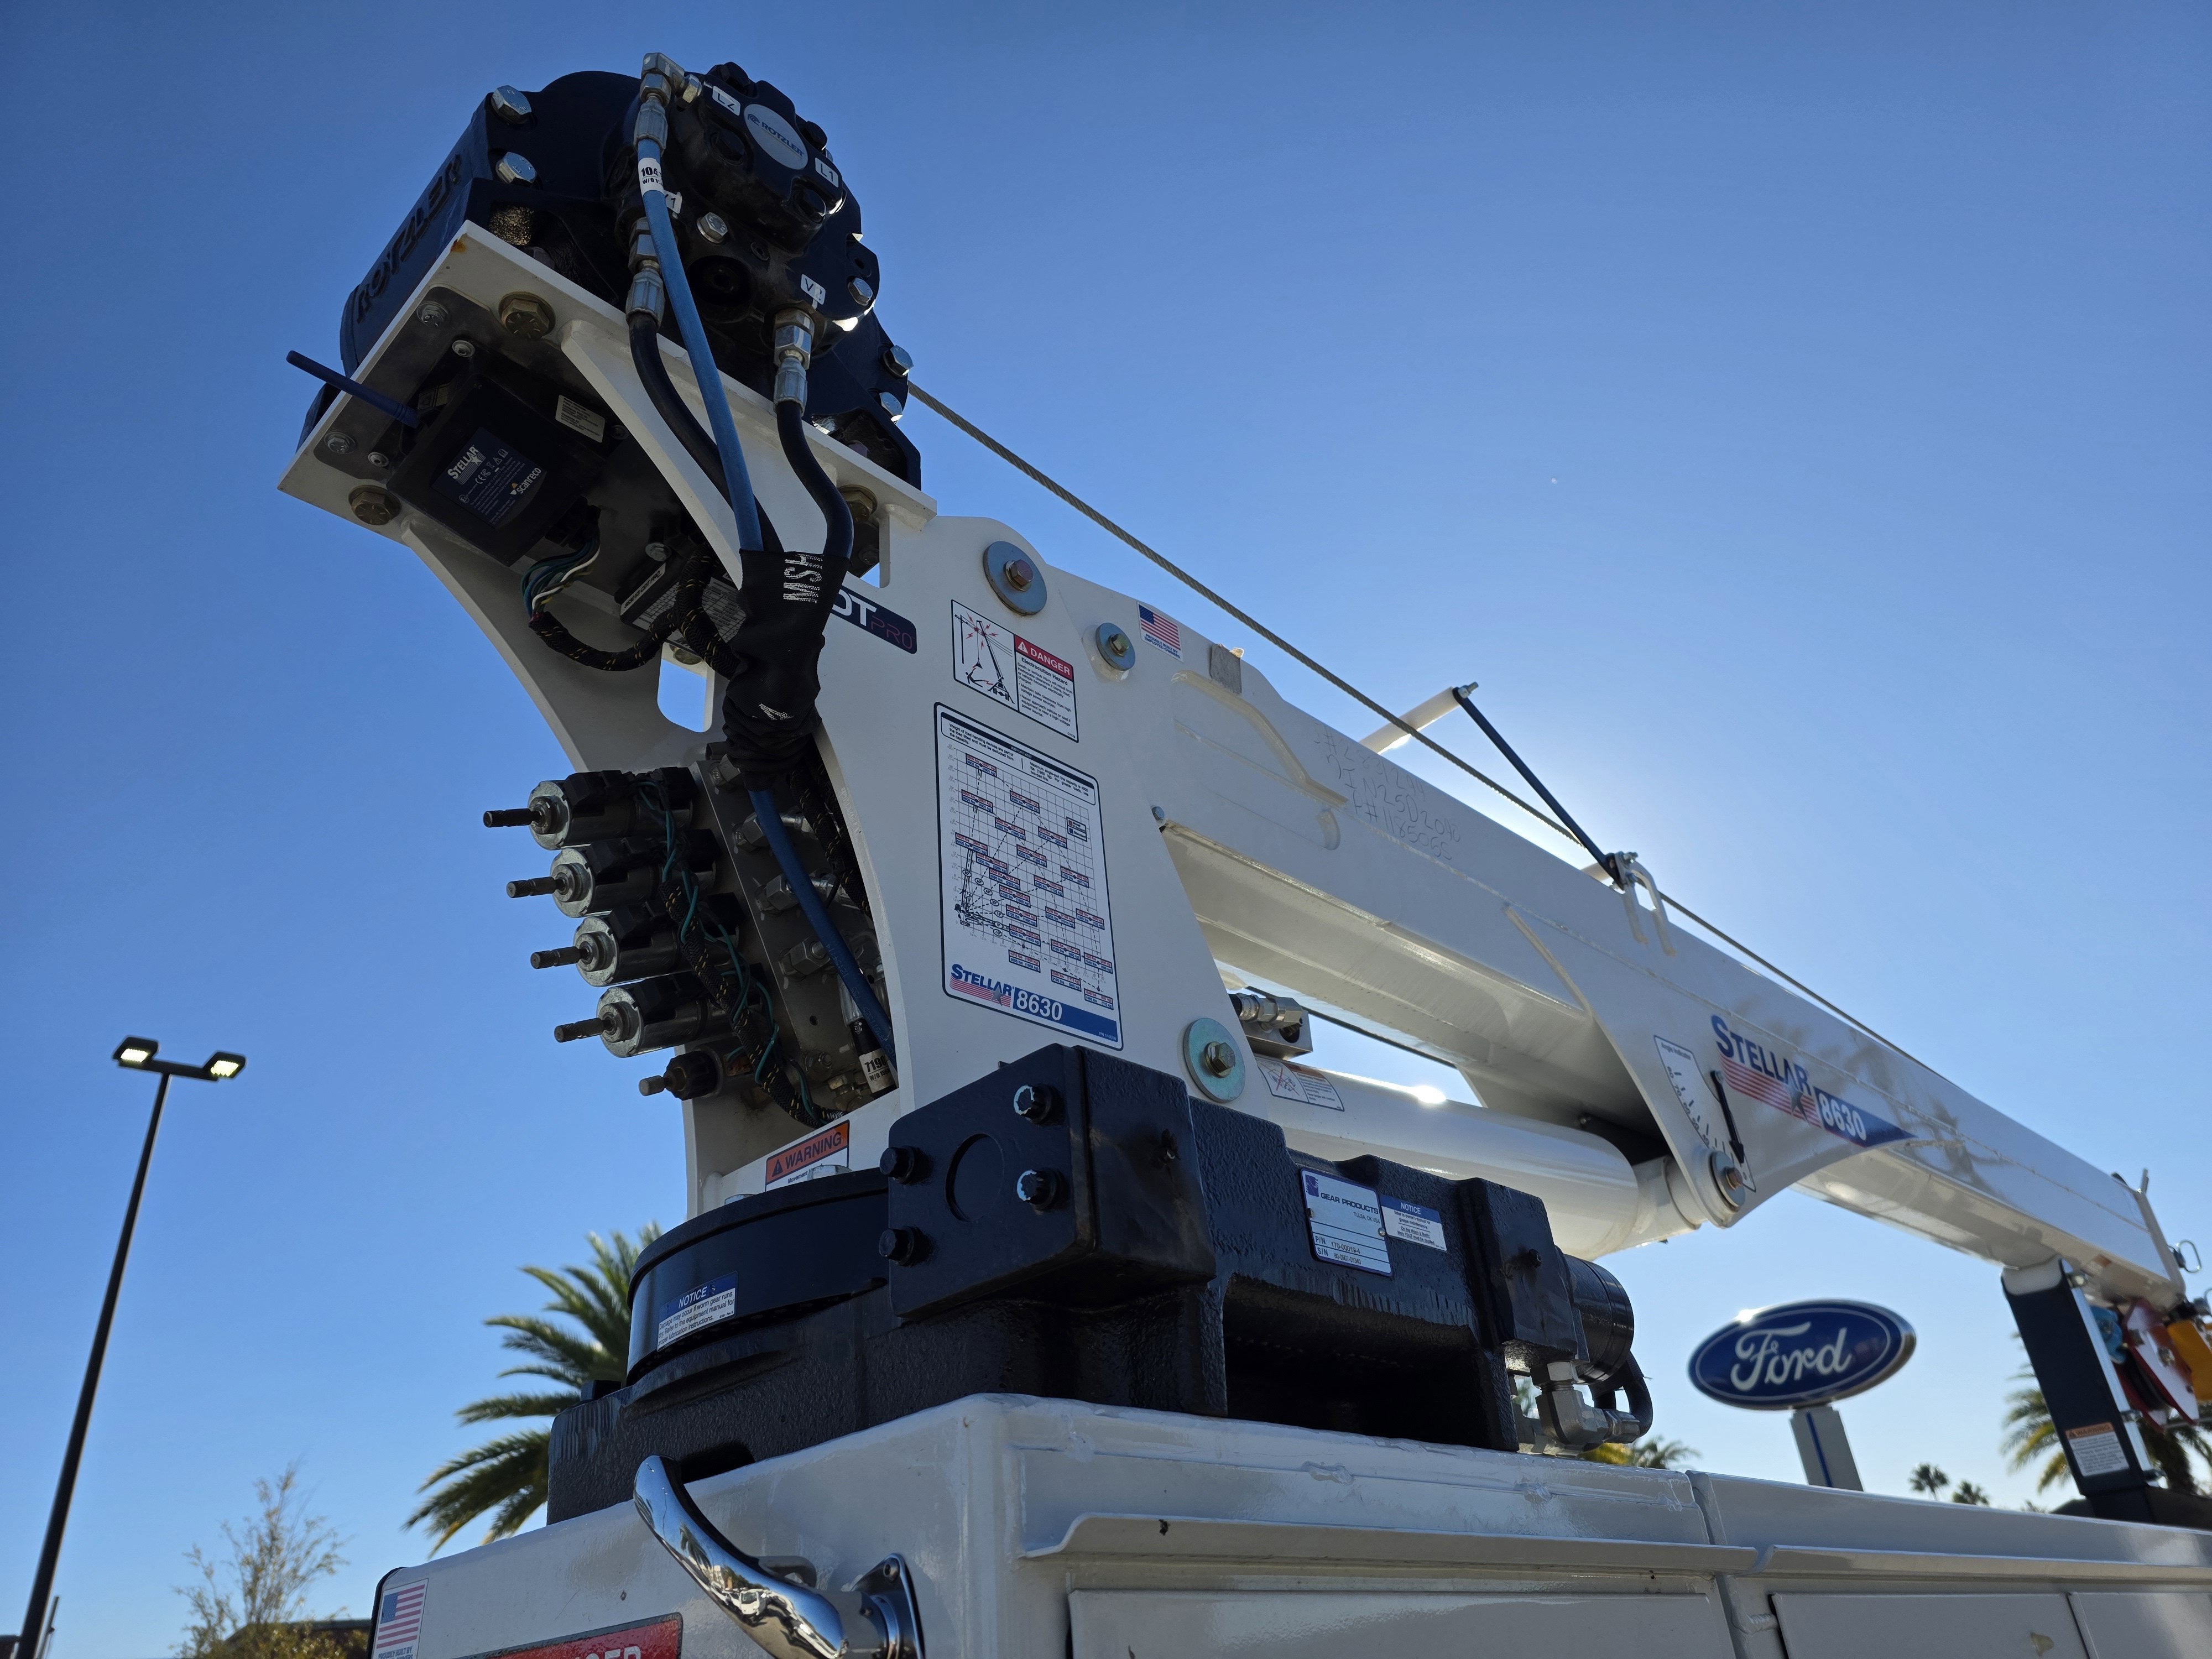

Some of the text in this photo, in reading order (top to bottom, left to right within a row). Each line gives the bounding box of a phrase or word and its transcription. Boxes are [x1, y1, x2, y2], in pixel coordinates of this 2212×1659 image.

[761, 121, 804, 157] ROTZLER
[820, 163, 834, 182] L1
[446, 444, 479, 479] STELLAR
[515, 466, 542, 494] scanreco
[871, 615, 912, 649] PRO
[1021, 656, 1067, 685] Electrocution Hazard
[1030, 647, 1070, 676] DANGER
[951, 963, 1063, 1022] STELLAR 8630
[1711, 1015, 1866, 1140] STELLAR 8630
[785, 1131, 842, 1170] WARNING
[1320, 1192, 1379, 1214] GEAR PRODUCTS
[1353, 1212, 1366, 1220] TULSA,
[1400, 1202, 1421, 1214] NOTICE
[1314, 1235, 1326, 1245] P/N
[1317, 1246, 1328, 1256] S/N
[678, 1286, 707, 1309] NOTICE
[681, 1308, 692, 1317] occur
[697, 1300, 708, 1310] worm
[709, 1295, 720, 1306] gear
[721, 1290, 733, 1301] runs
[665, 1324, 674, 1334] Refer
[686, 1307, 708, 1324] equipment
[709, 1300, 726, 1314] manual
[1730, 1321, 1852, 1392] Ford
